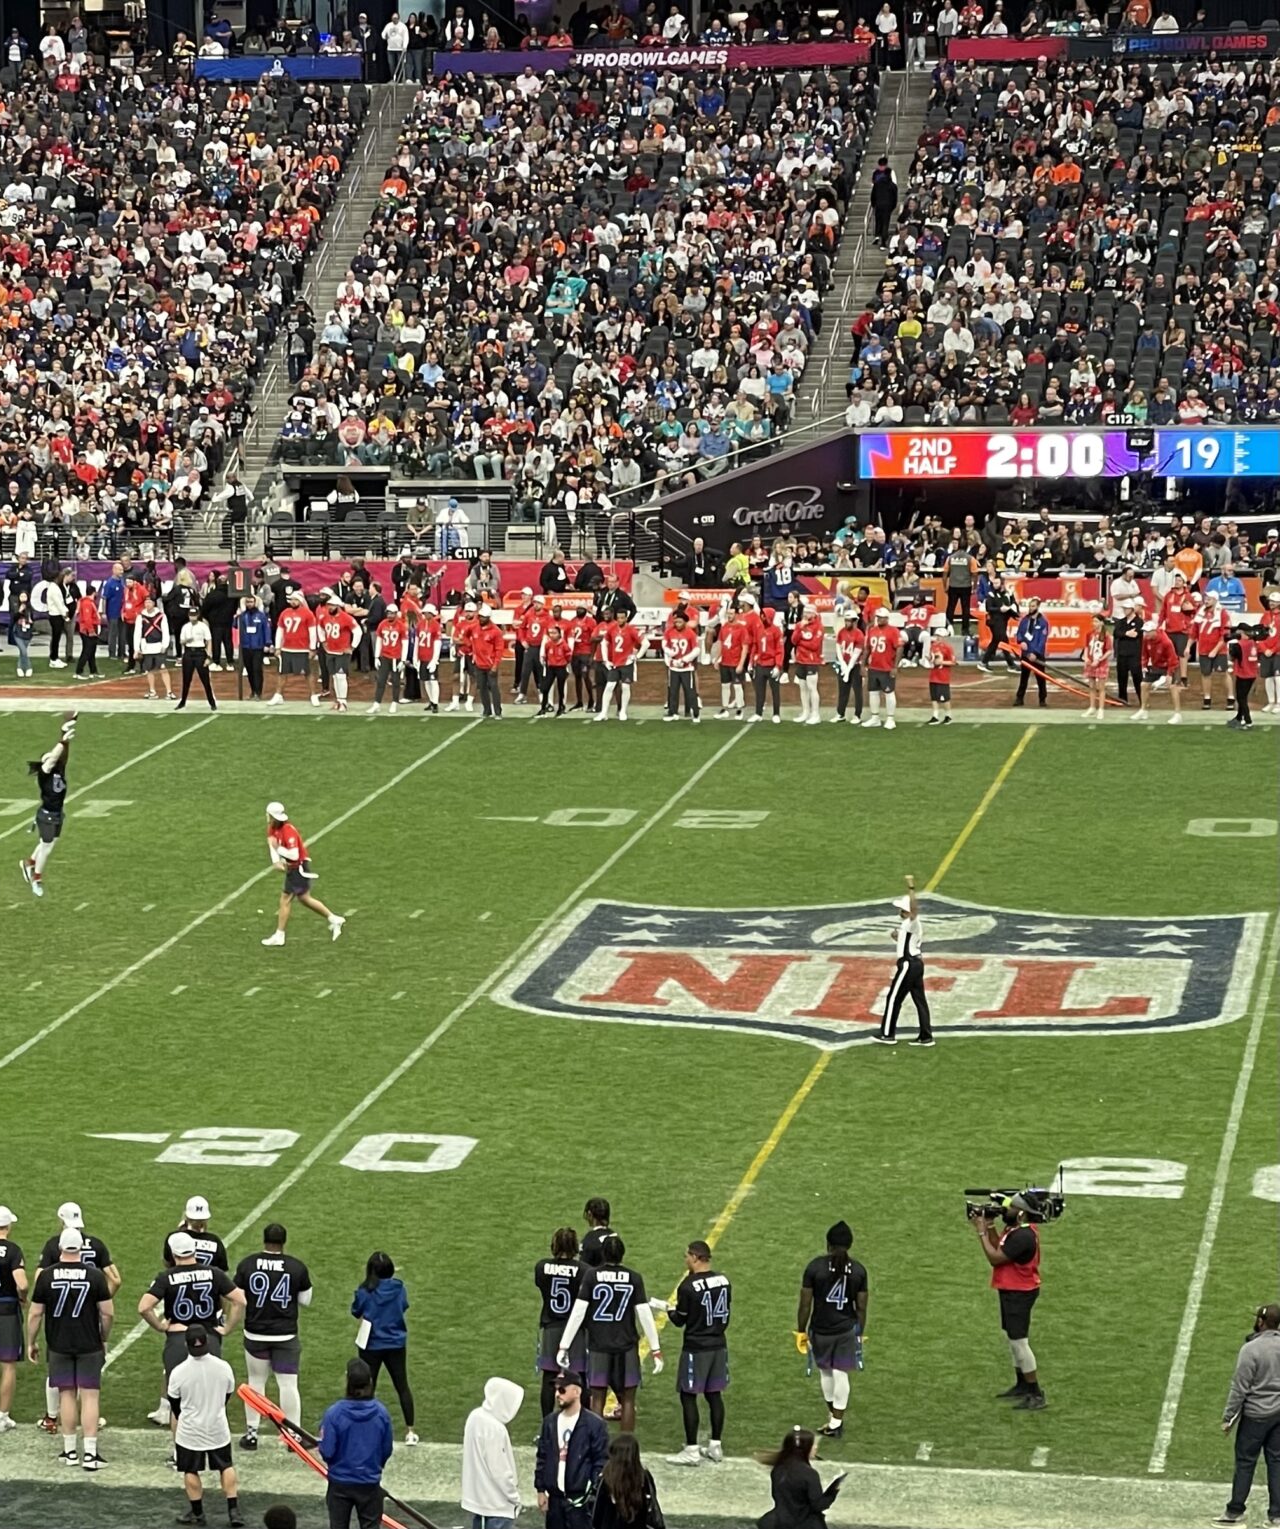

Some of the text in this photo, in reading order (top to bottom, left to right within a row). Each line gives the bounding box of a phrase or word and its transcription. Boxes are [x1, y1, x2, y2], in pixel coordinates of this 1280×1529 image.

[913, 12, 923, 24] 17
[276, 32, 285, 42] 17
[1210, 35, 1268, 49] GAMES
[1106, 414, 1134, 425] C112
[1245, 408, 1258, 419] 52
[909, 438, 953, 456] 2ND
[986, 434, 1104, 478] 2:00
[1176, 437, 1220, 469] 19
[903, 457, 957, 475] HALF
[454, 548, 478, 559] C111
[1005, 547, 1024, 566] 82
[234, 570, 244, 590] 1
[775, 567, 792, 585] 18
[551, 598, 595, 608] GATORAD
[283, 616, 302, 634] 97
[324, 622, 341, 640] 98
[530, 622, 541, 638] 9
[382, 630, 400, 648] 39
[418, 630, 432, 649] 21
[614, 635, 624, 652] 2
[723, 633, 732, 650] 4
[760, 637, 767, 653] 1
[870, 636, 886, 653] 95
[578, 949, 1151, 1024] NFL
[256, 1258, 285, 1273] PAYNE
[543, 1262, 579, 1279] RAMSEY
[51, 1281, 90, 1318] 77
[249, 1271, 292, 1310] 94
[550, 1276, 571, 1314] 5
[826, 1275, 848, 1310] 4
[173, 1281, 214, 1321] 63
[592, 1283, 634, 1322] 27
[701, 1287, 729, 1326] 14
